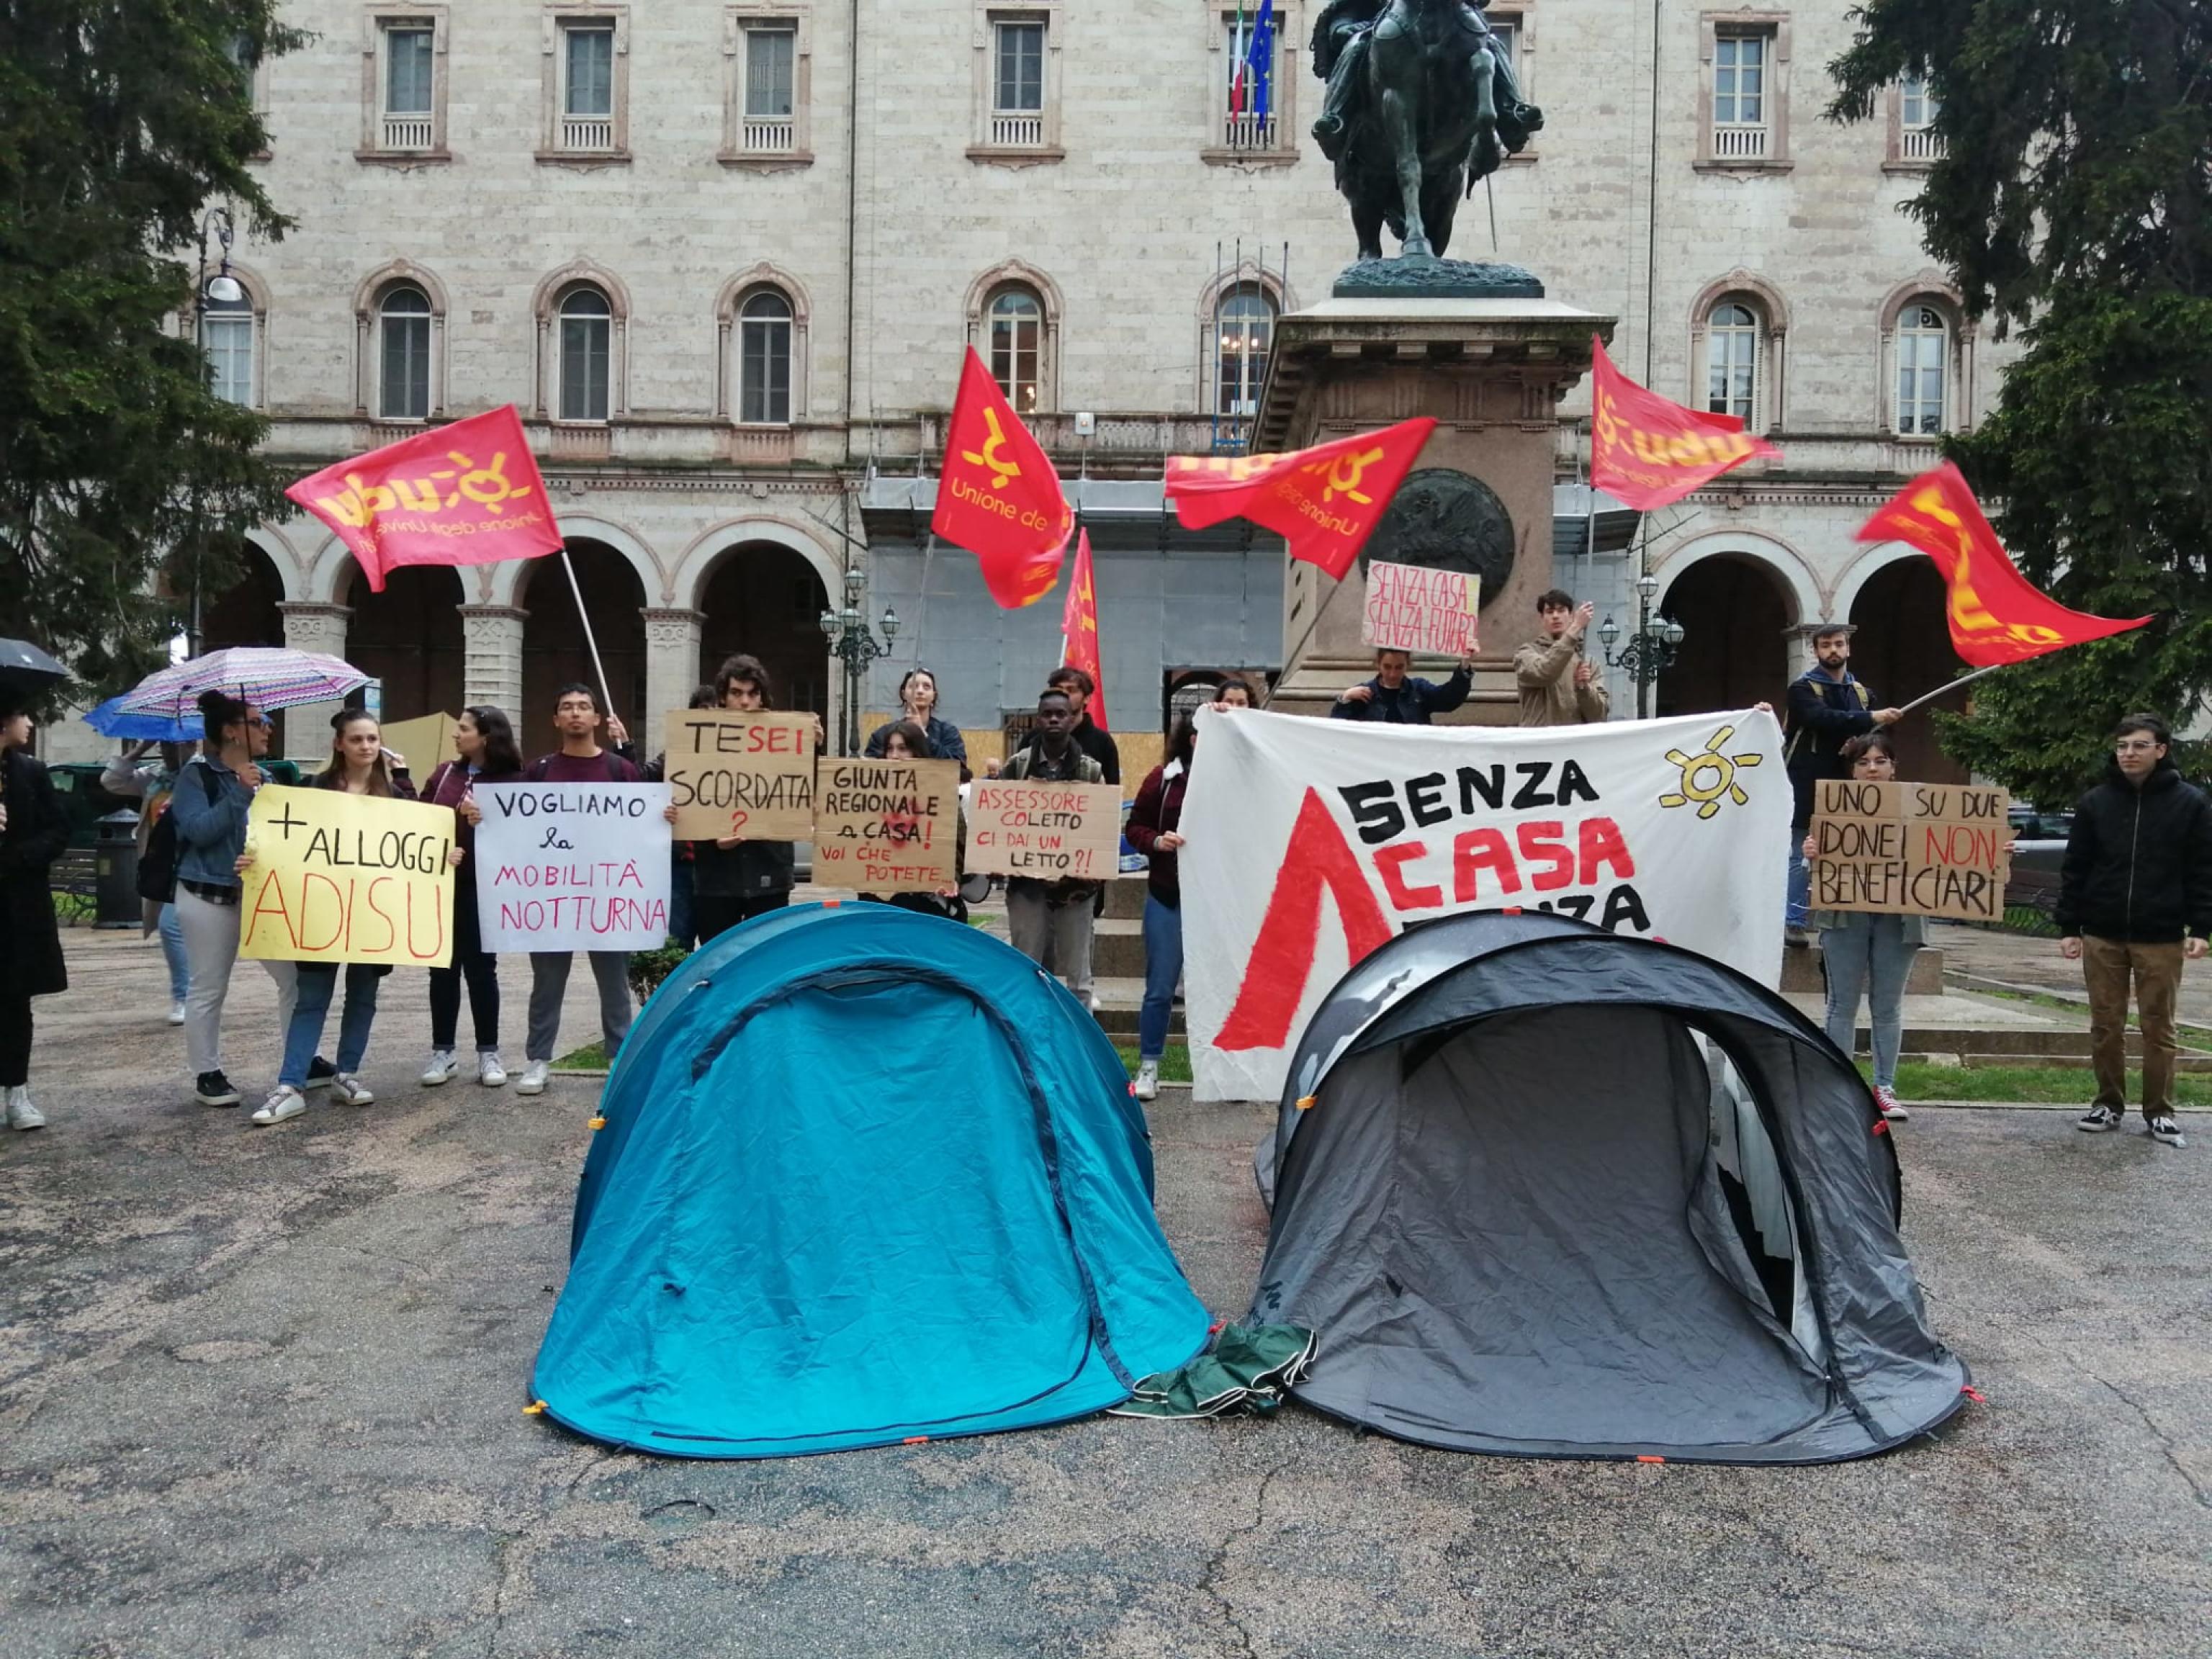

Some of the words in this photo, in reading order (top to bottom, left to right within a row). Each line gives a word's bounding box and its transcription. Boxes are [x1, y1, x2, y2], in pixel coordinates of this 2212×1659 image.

[952, 477, 1016, 519] Unione
[1372, 564, 1427, 606] SENZA
[1431, 572, 1467, 611] CASA
[1365, 600, 1423, 649] SENZA
[670, 769, 812, 810] SCORDATA
[833, 766, 917, 791] GIUNTA
[495, 792, 646, 817] VOGLIAMO
[826, 793, 940, 817] REGIONALE
[978, 788, 1089, 813] ASSESSORE
[1338, 759, 1600, 844] SENZA
[1825, 783, 1881, 816] UNO
[1915, 788, 1947, 817] SU
[1961, 791, 2000, 818] DUE
[732, 809, 748, 837] ?
[864, 820, 932, 850] CASA!
[1000, 811, 1082, 830] COLETTO
[303, 827, 450, 876] ALLOGGI
[540, 827, 575, 850] la
[856, 846, 893, 862] CHE
[976, 832, 995, 846] CI
[1007, 832, 1030, 848] DAI
[1039, 835, 1061, 850] UN
[1819, 820, 1907, 860] IDONEI
[1925, 825, 1997, 870] NON
[494, 858, 644, 889] MOBILITÀ
[1372, 817, 1635, 910] CASA
[1819, 860, 1998, 917] BENEFICIARI
[245, 868, 444, 959] ADISU
[501, 896, 667, 934] NOTTURNA
